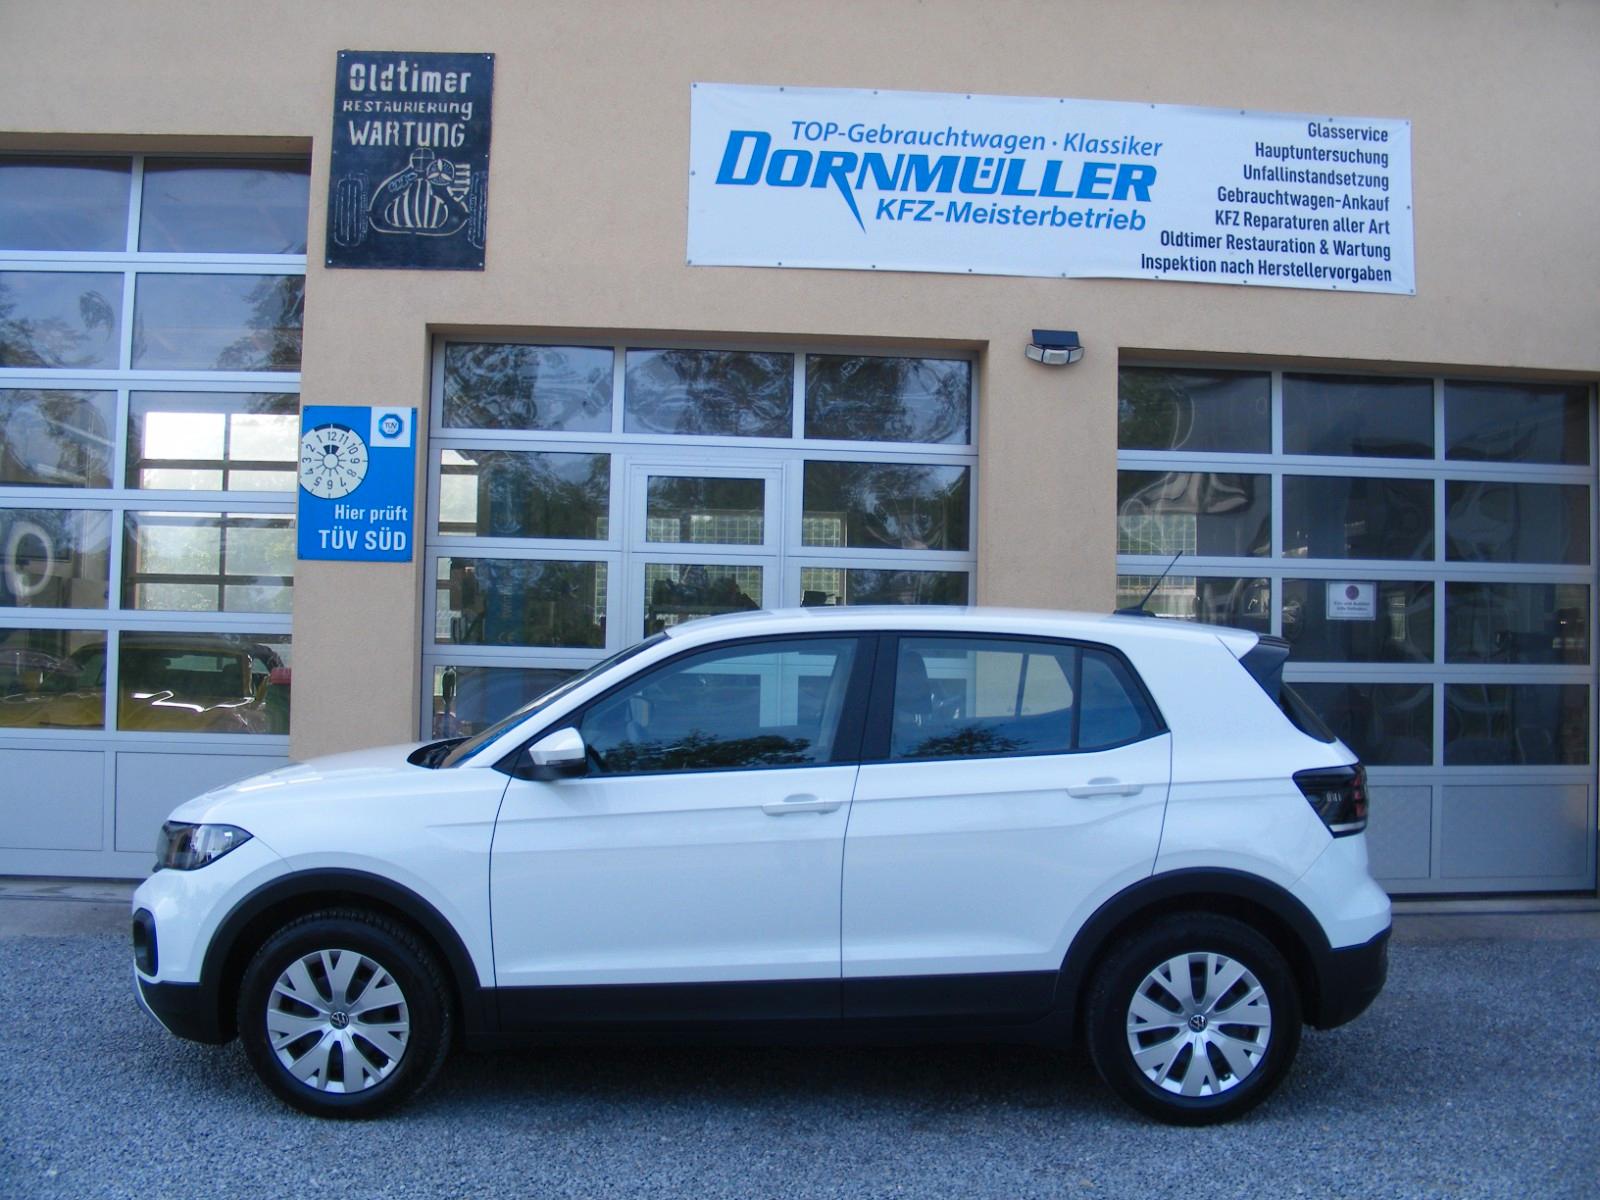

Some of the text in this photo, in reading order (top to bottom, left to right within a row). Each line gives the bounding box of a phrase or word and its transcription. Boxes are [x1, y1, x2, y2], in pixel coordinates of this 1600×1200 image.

[350, 60, 472, 93] Oldtimer
[792, 121, 1163, 156] TOP-Gebrauchtwagen Klassiker
[1308, 122, 1389, 142] Glasservice
[1255, 141, 1389, 168] Hauptuntersuchung
[715, 130, 1157, 234] DORNMÜLLER
[1243, 164, 1389, 191] Unfallinstandsetzung
[1217, 186, 1390, 212] Gebrauchtwagen-Ankauf
[875, 198, 1146, 231] KFZ-Meisterbetrieb
[1215, 210, 1390, 235] KFZ Reparaturen aller Art
[1160, 230, 1391, 262] Oldtimer Restauration & Wartung
[1141, 253, 1392, 283] Inspektion nach Herstellervorgaben
[316, 434, 323, 443] 1
[327, 431, 337, 441] 12
[338, 433, 349, 445] 11
[305, 443, 316, 453] 2
[346, 442, 359, 455] 10
[304, 467, 314, 476] 4
[313, 476, 323, 487] 5
[340, 477, 347, 487] 7
[346, 469, 357, 478] 8
[334, 504, 408, 524] Hier prüft
[318, 526, 407, 551] TÜV SÜD
